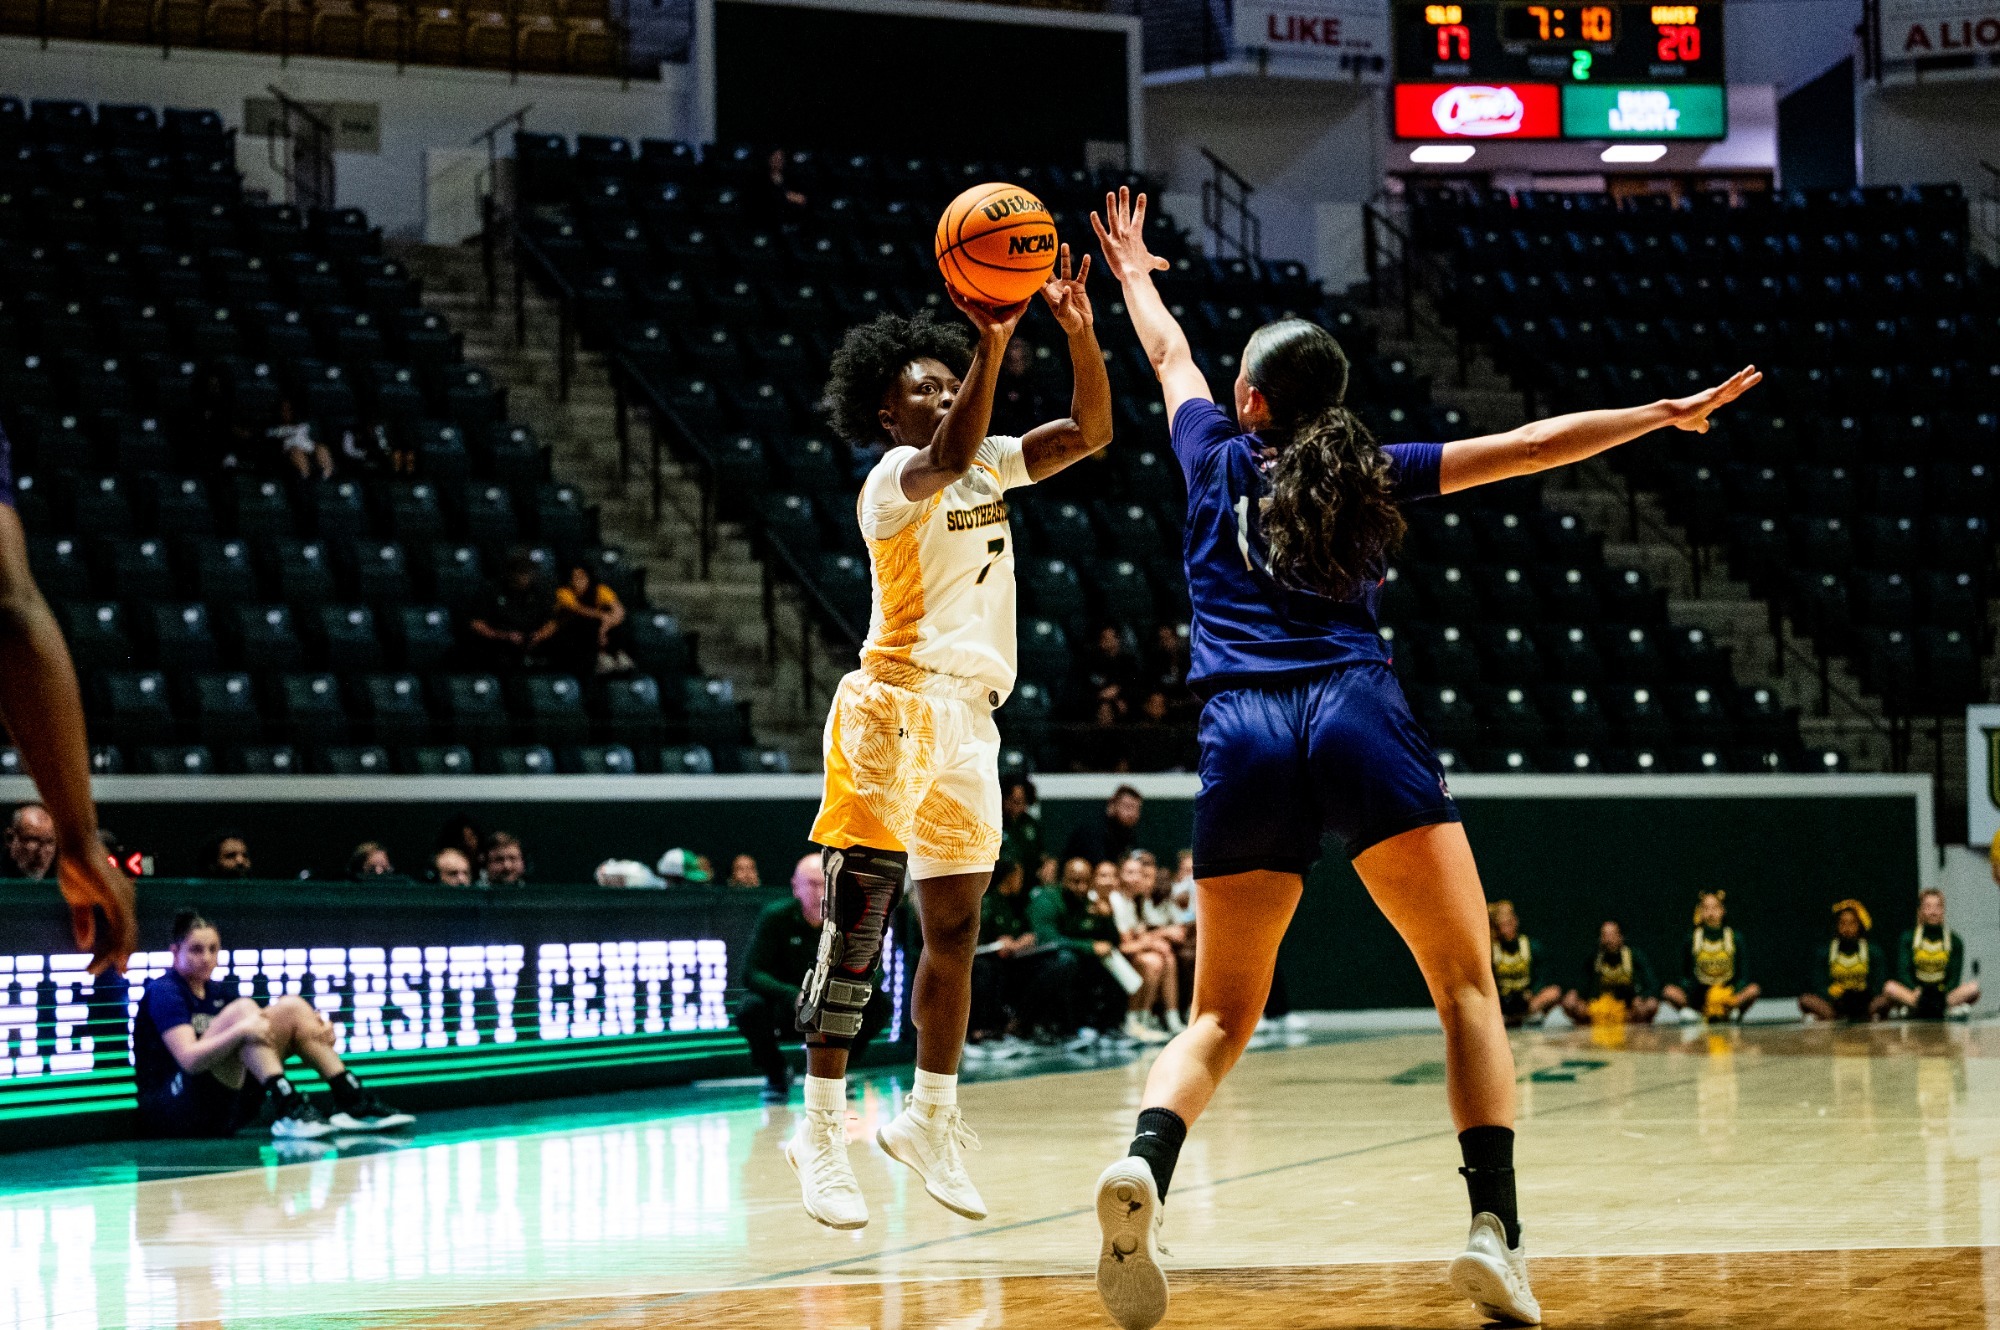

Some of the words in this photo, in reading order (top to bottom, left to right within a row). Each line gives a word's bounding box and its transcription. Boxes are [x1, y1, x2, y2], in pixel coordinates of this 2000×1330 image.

[1527, 6, 1612, 41] 7:10
[1904, 23, 1932, 51] A
[1438, 25, 1470, 60] 17
[1658, 25, 1700, 61] 20
[1572, 50, 1592, 80] 2
[1008, 233, 1054, 255] NCAA
[974, 537, 1005, 585] 7
[538, 940, 730, 1042] CENTER
